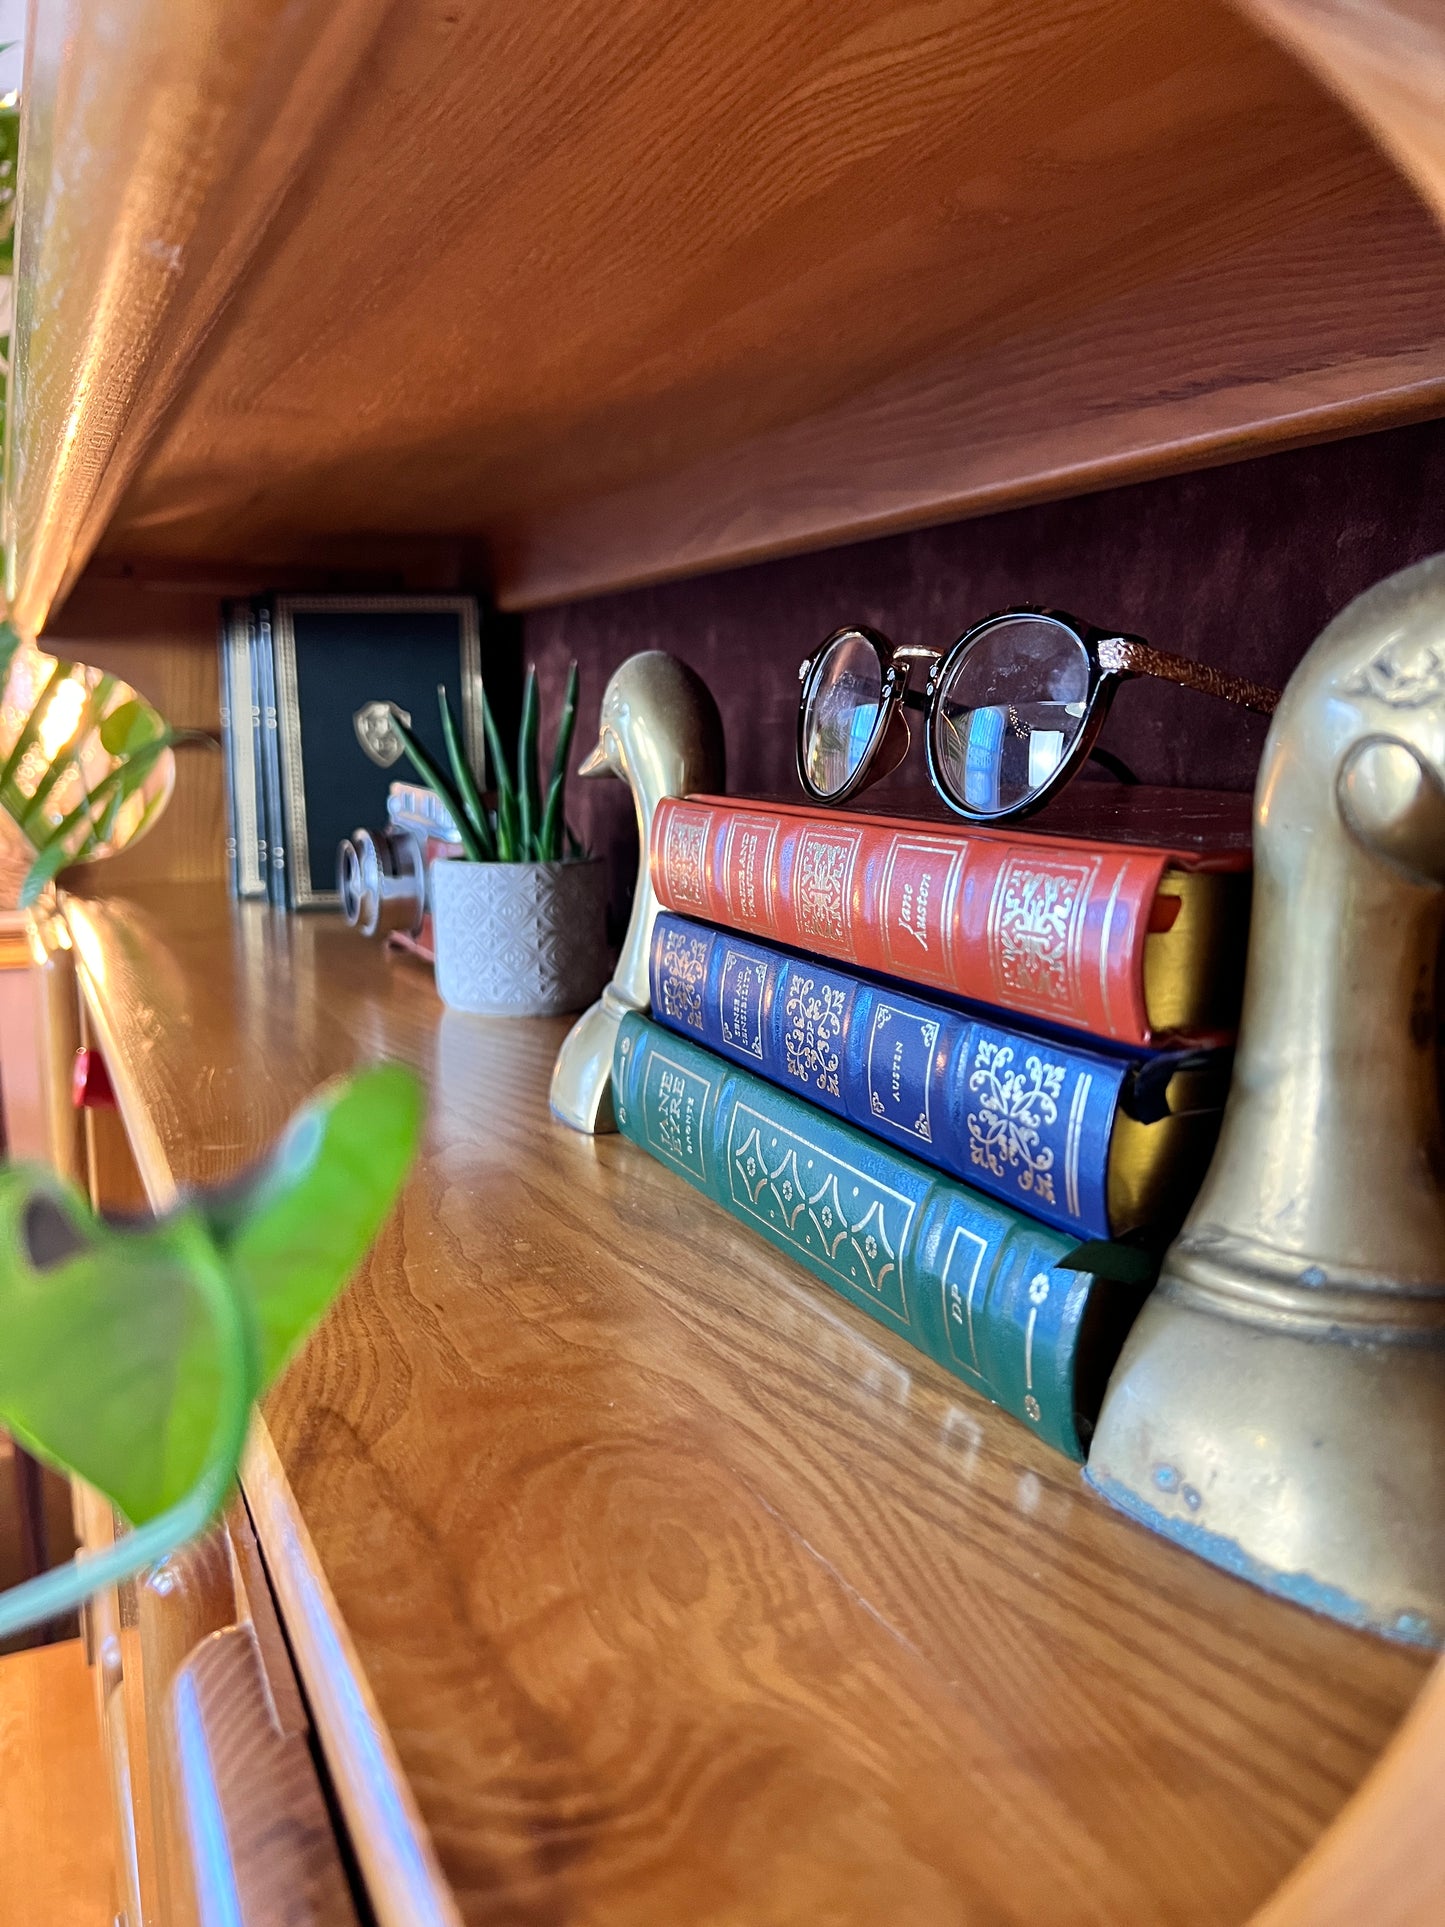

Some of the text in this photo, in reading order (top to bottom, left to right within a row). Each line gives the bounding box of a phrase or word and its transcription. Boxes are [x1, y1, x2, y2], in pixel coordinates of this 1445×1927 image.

[738, 832, 749, 868] AND
[897, 883, 914, 935] Jane
[733, 970, 744, 1037] SENSE AND
[740, 966, 752, 1046] SENSIBILITY
[806, 1020, 815, 1048] DP
[892, 1040, 904, 1102] AUSTEN
[658, 1071, 674, 1151] JANE
[668, 1076, 686, 1156] EYRE
[951, 1283, 963, 1325] DP
